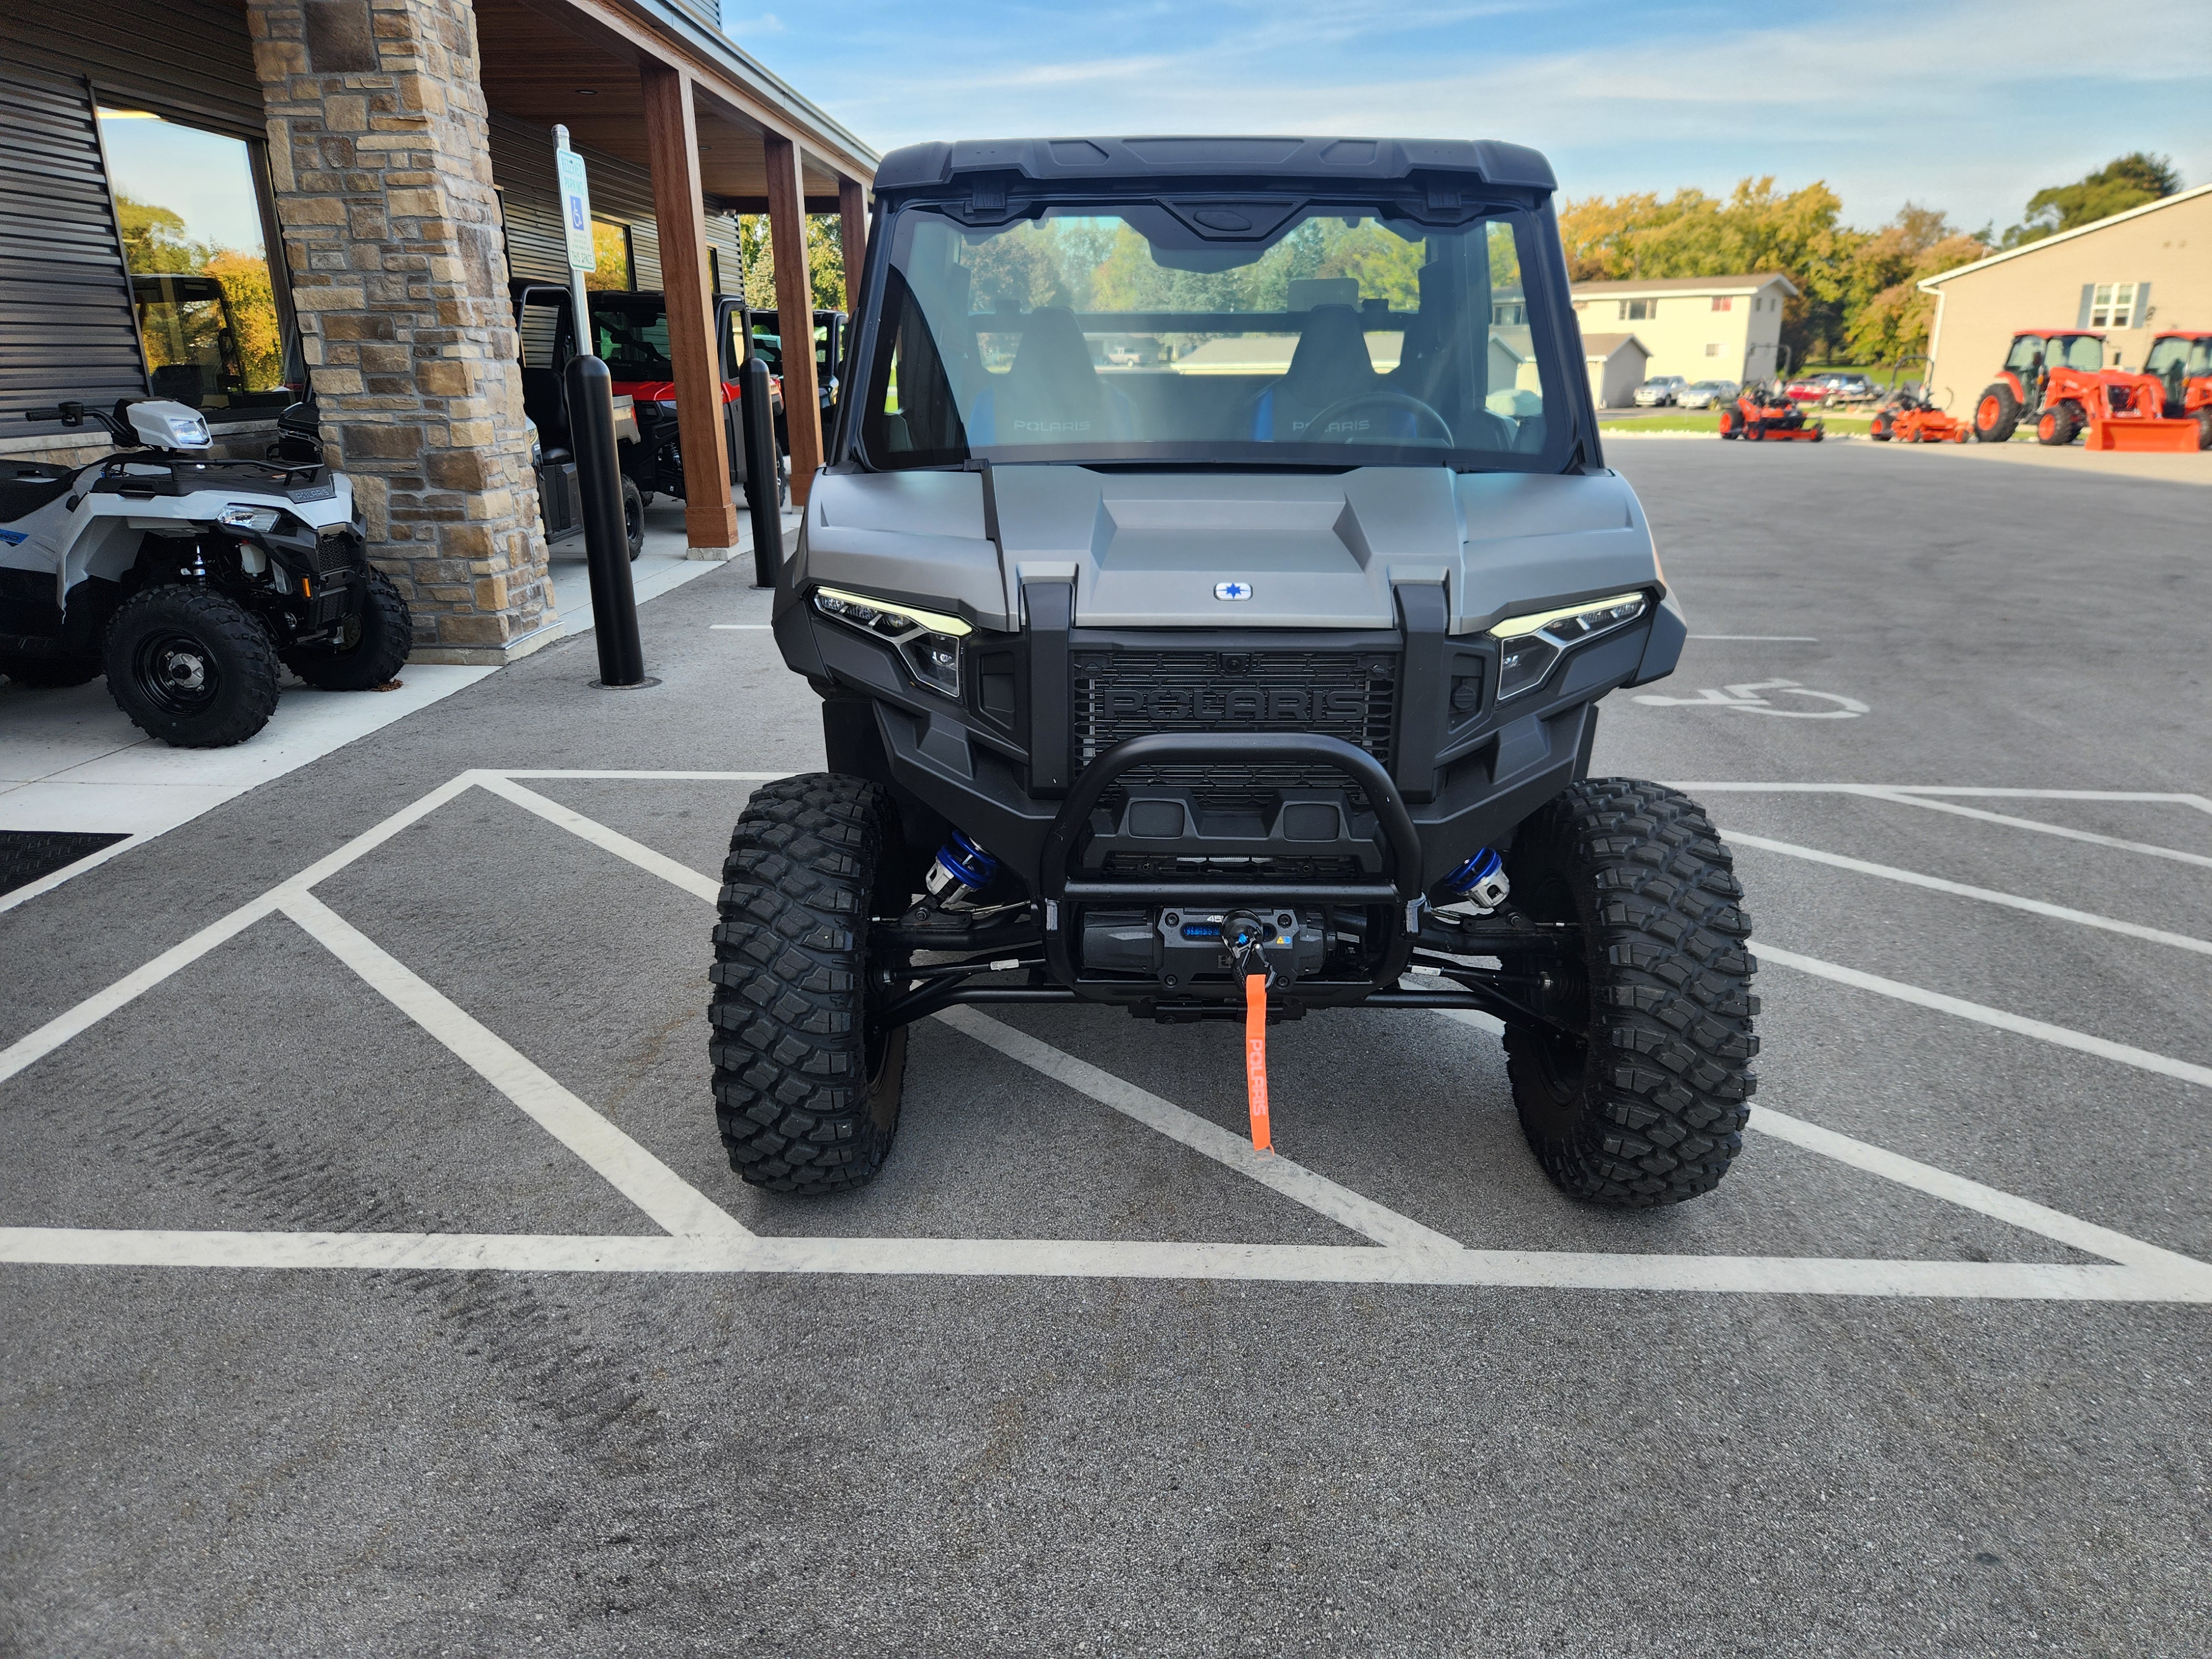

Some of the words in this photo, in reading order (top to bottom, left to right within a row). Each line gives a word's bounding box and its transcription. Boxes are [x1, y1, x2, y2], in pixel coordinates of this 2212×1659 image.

[561, 157, 583, 177] RESERVED
[564, 176, 583, 195] PARKING
[571, 251, 580, 263] THIS
[581, 253, 593, 265] SPACE
[1014, 420, 1091, 432] POLARIS
[1292, 420, 1370, 432] PARIS
[295, 489, 330, 499] POLARIS
[1104, 689, 1366, 720] POLARIS
[1249, 1039, 1266, 1117] POLARIS
